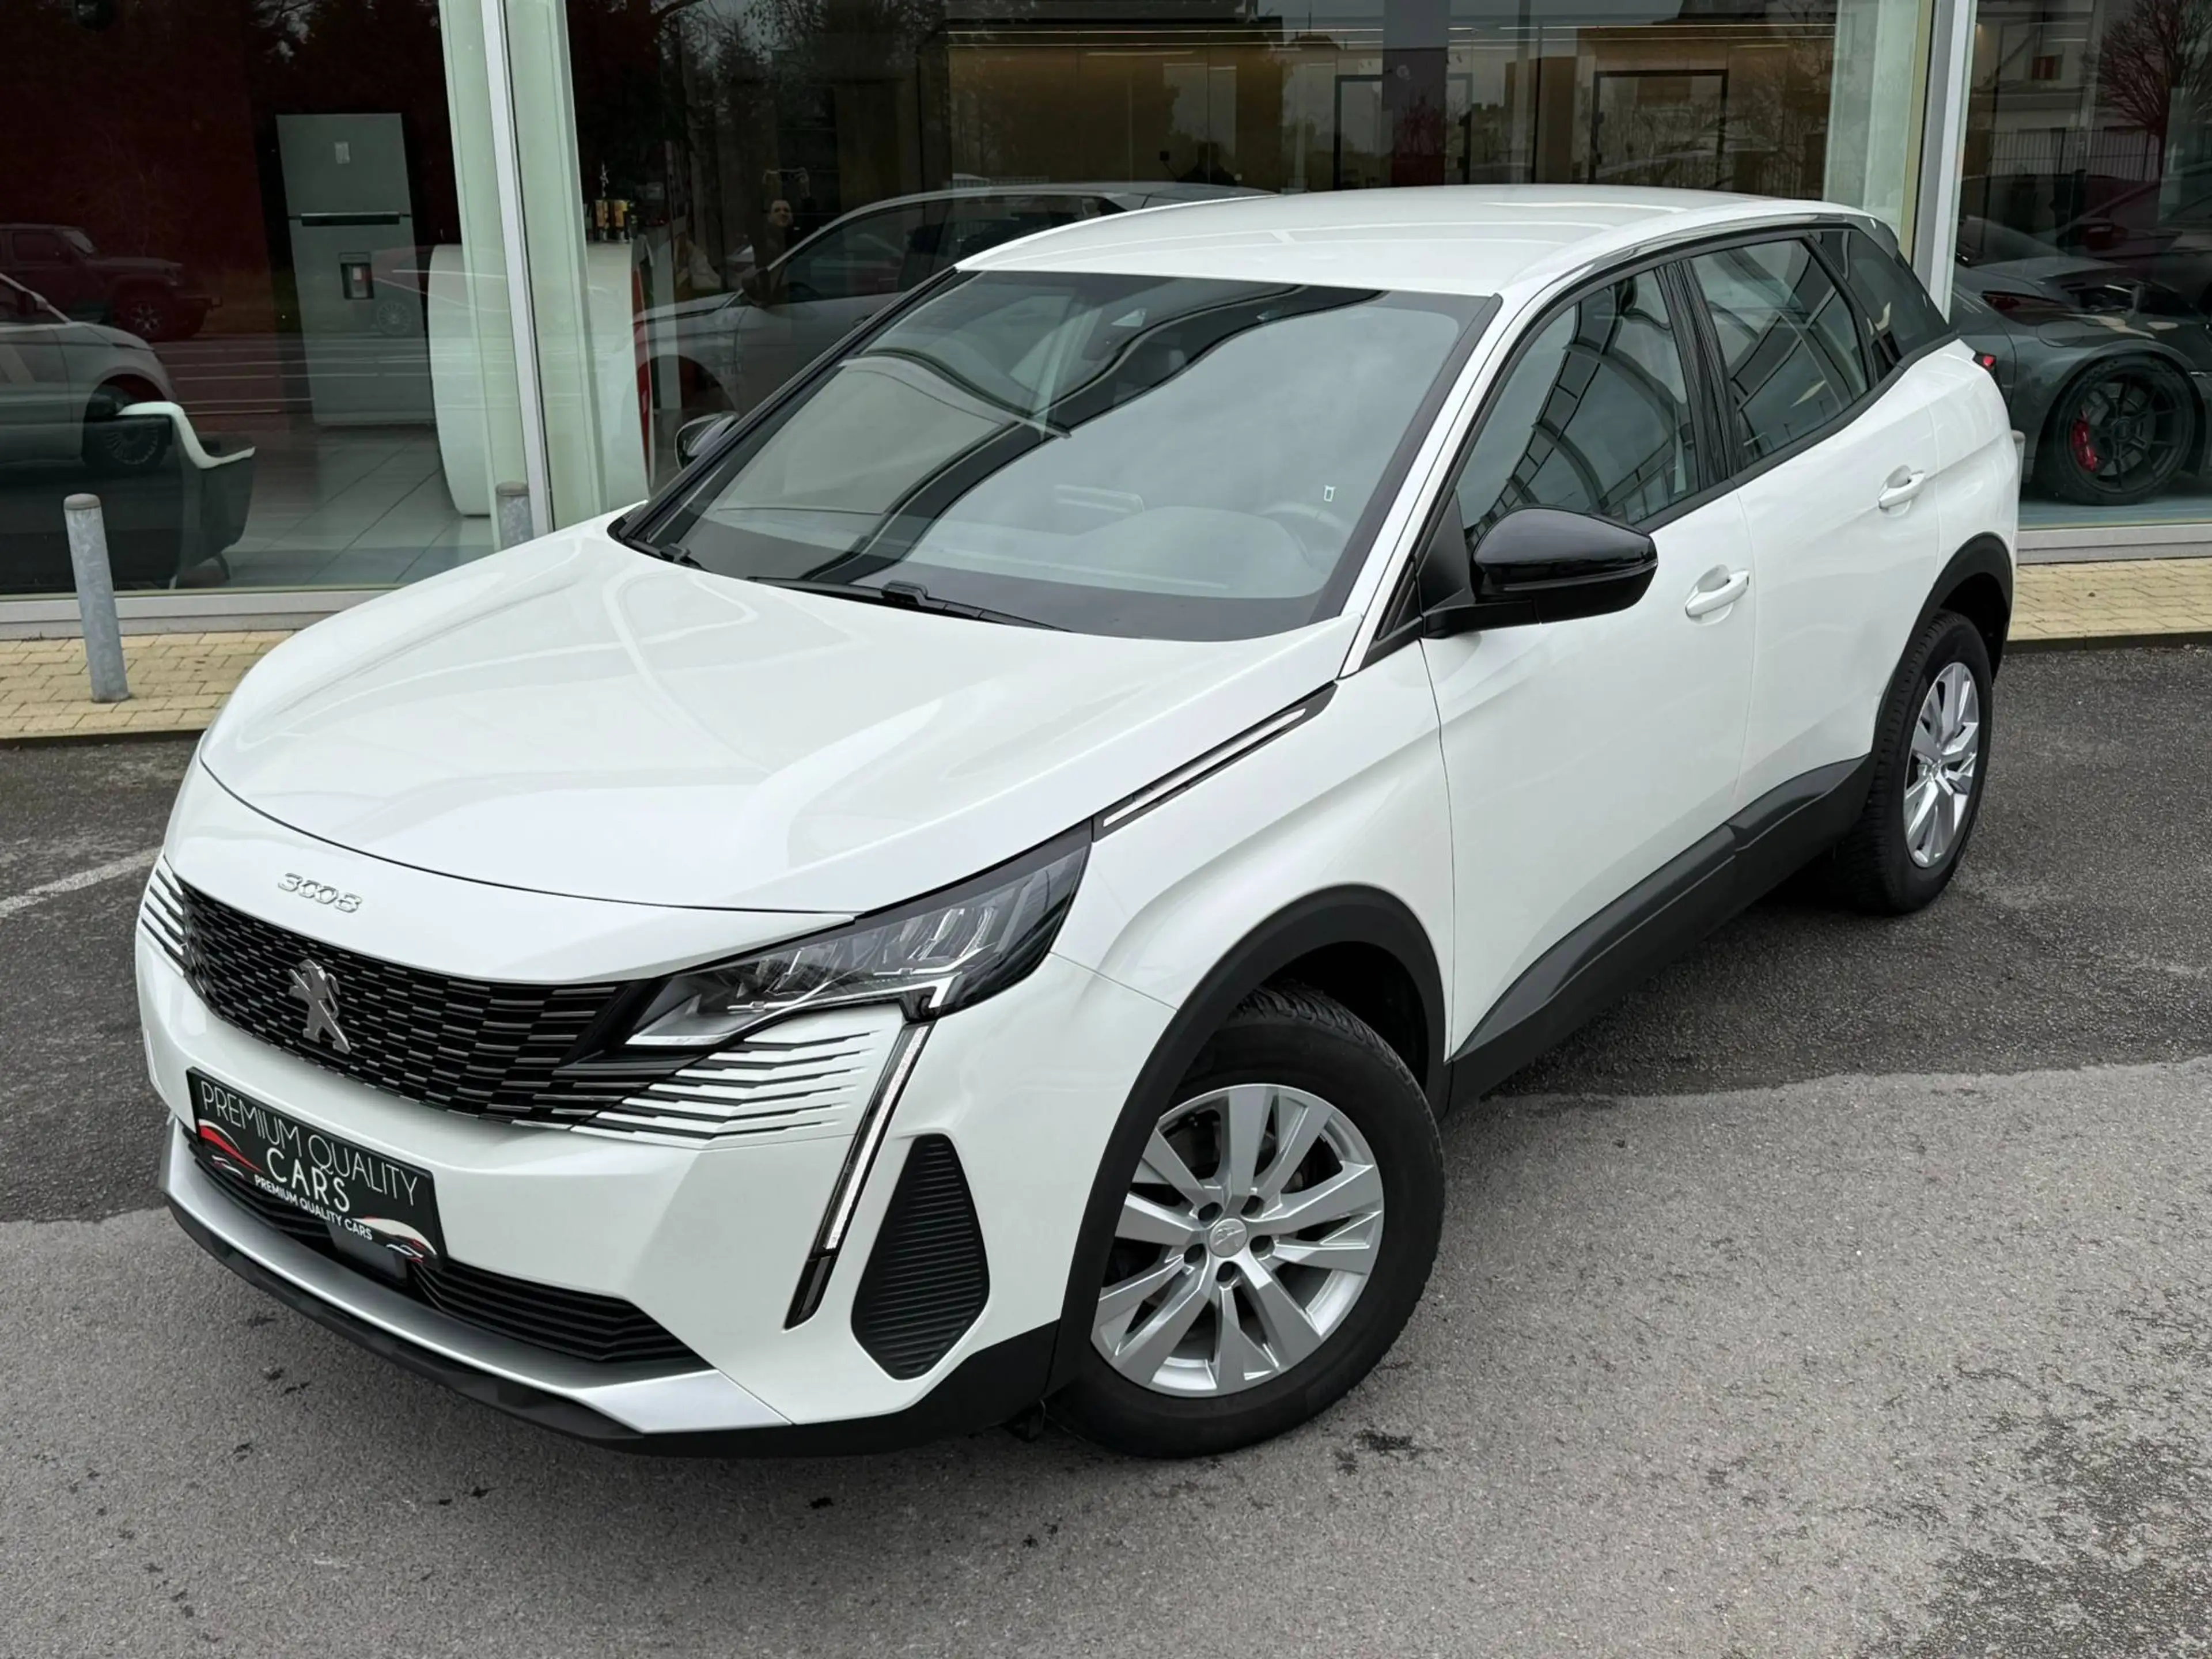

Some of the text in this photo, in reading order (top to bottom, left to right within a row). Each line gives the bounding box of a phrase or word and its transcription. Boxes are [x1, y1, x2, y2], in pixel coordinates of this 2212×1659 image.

[278, 872, 362, 913] 3008
[200, 1081, 418, 1206] PREMIUM QUALITY
[254, 1174, 373, 1240] PREMIUM QUALITY CARS
[267, 1147, 350, 1213] CARS
